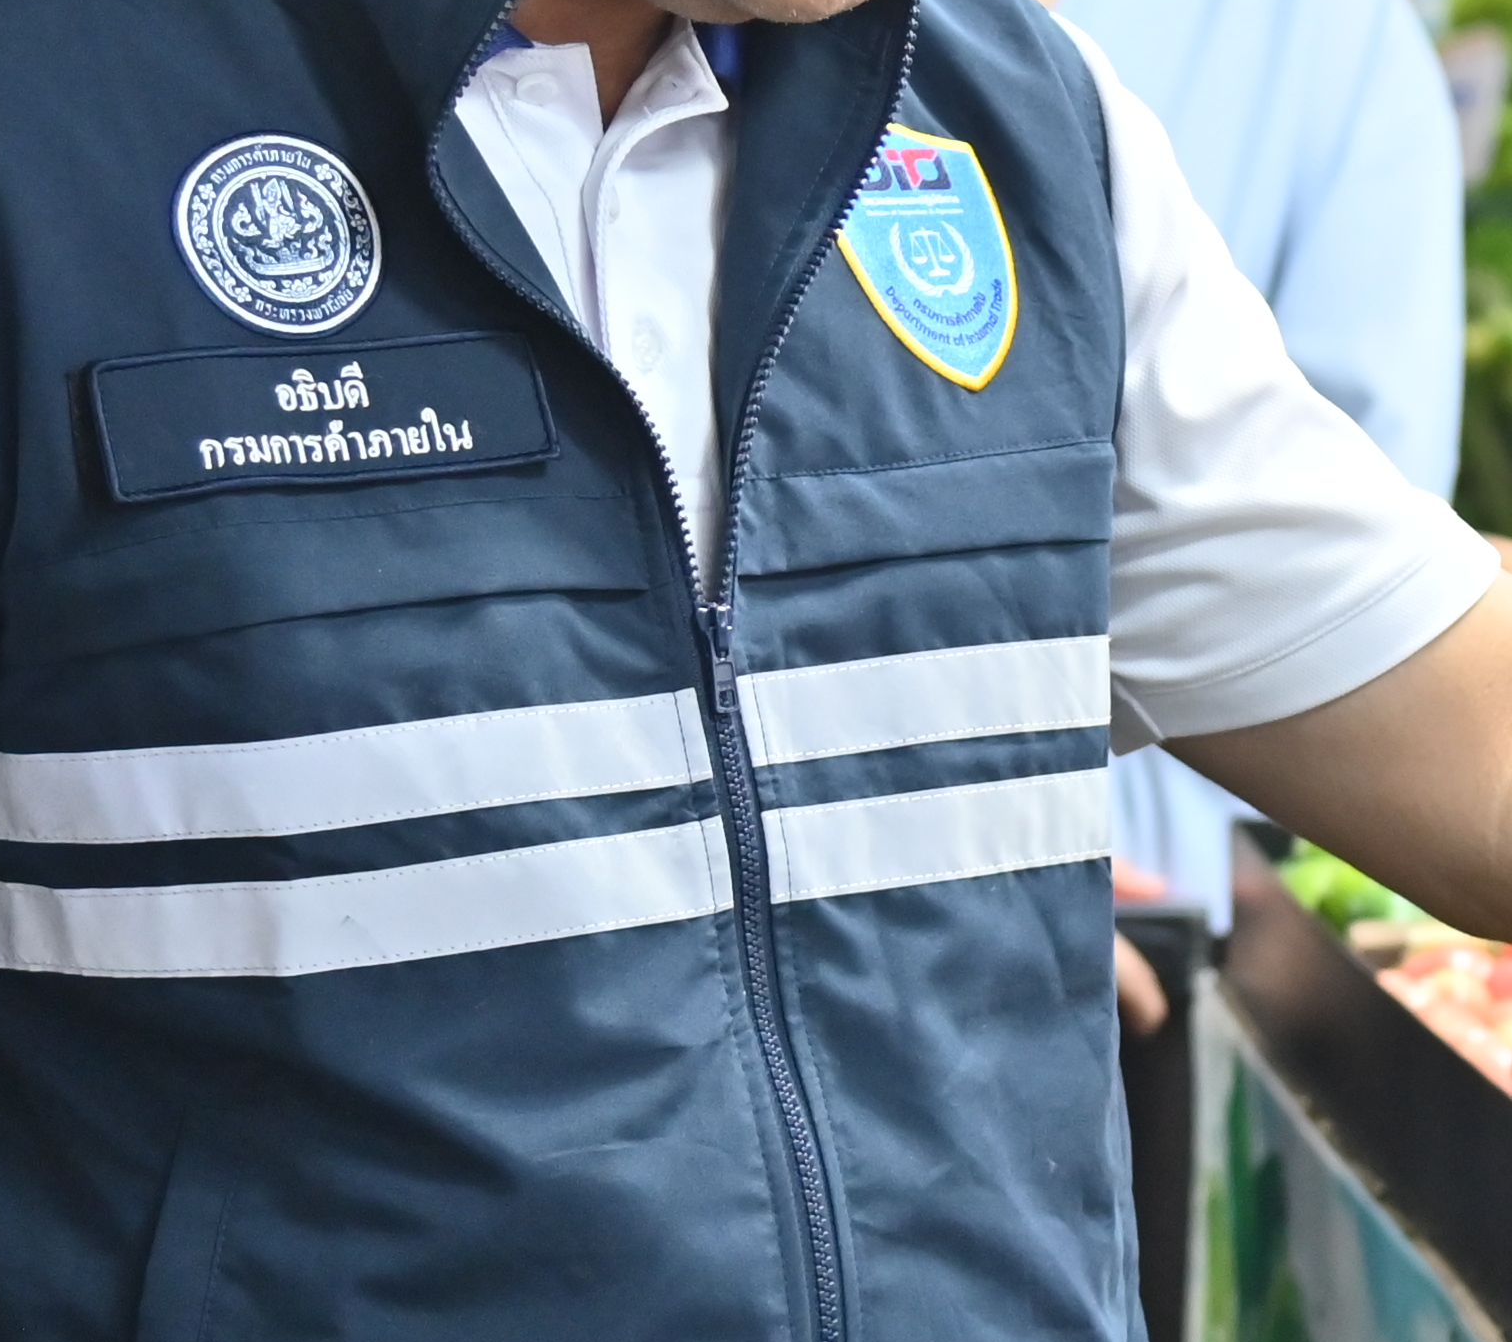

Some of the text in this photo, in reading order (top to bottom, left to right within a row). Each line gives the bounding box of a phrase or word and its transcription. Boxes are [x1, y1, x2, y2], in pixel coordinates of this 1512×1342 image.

[210, 144, 312, 185] กรมการค้าภายใน
[885, 285, 951, 346] Department
[274, 361, 370, 413] อธิบดี
[199, 407, 474, 470] กรมการค้าภายใน
